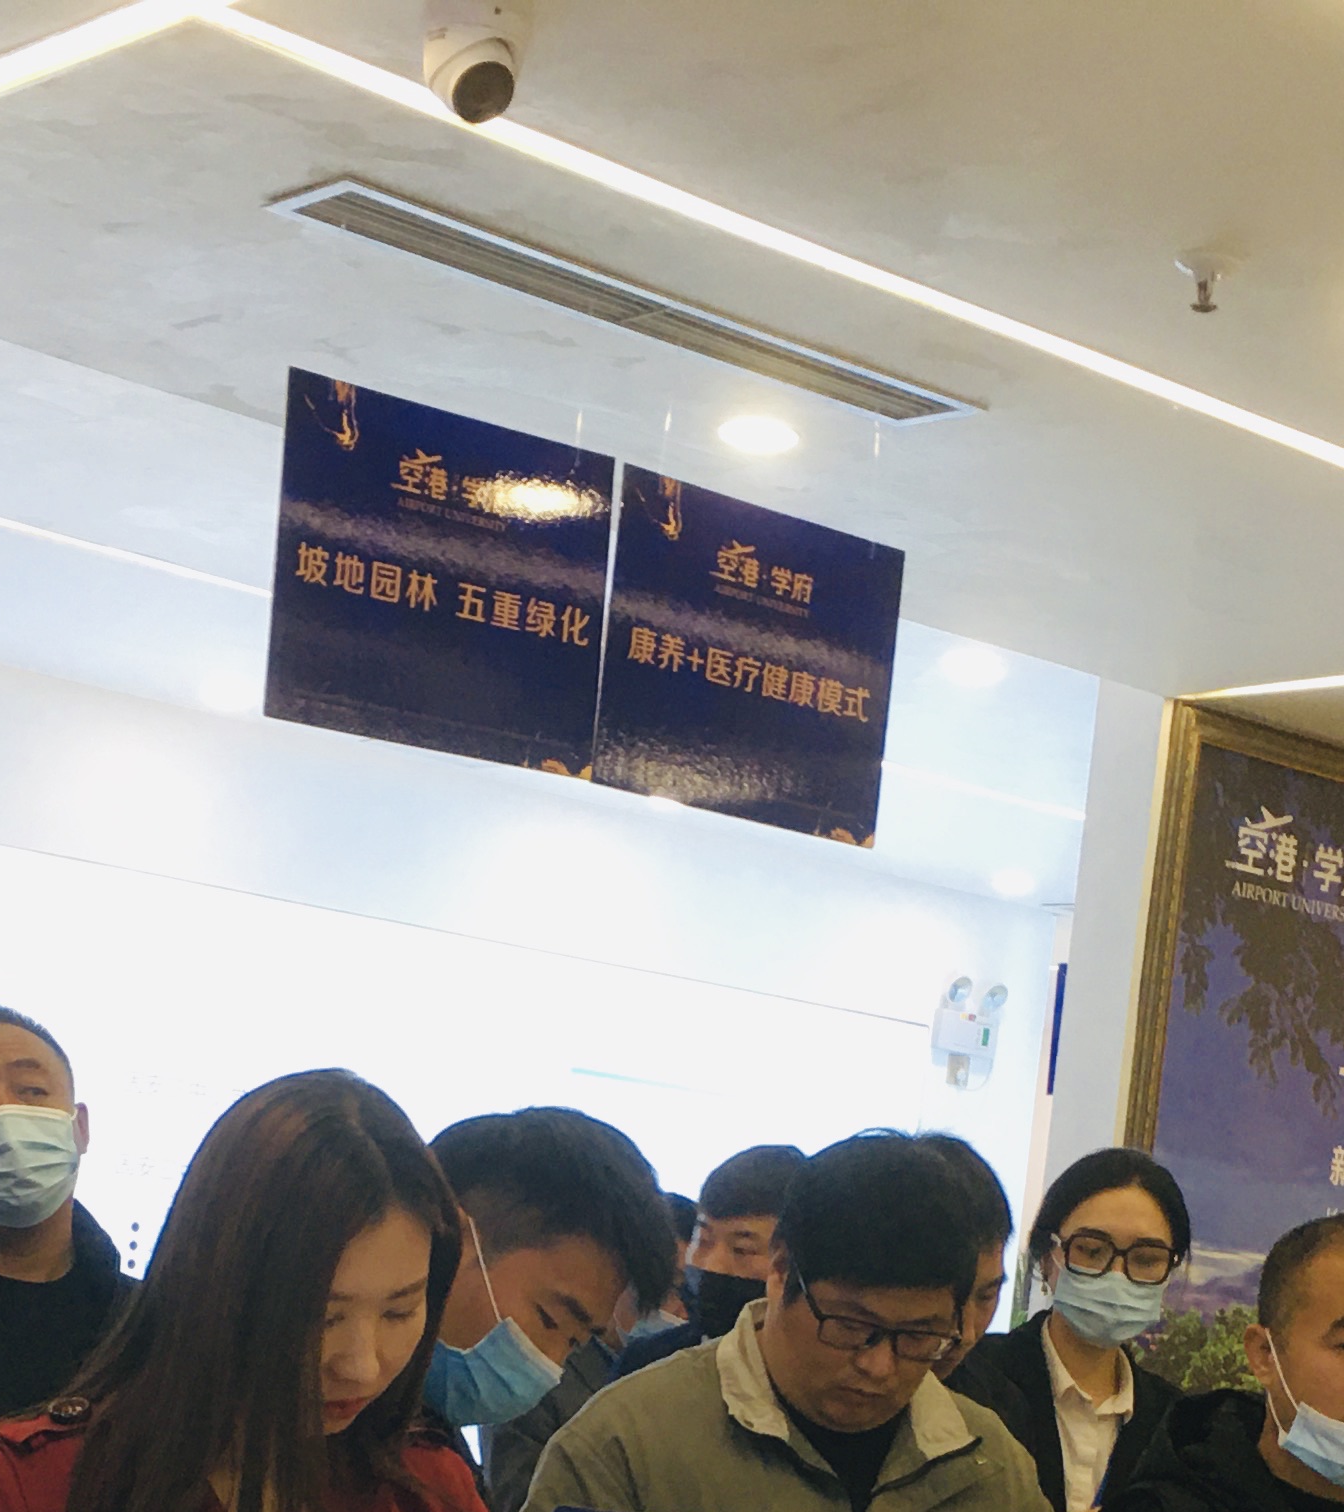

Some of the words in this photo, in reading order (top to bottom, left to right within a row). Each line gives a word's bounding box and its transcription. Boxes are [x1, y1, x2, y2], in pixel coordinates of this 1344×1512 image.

[296, 542, 439, 612] 坡地园林
[456, 583, 590, 647] 五重绿化
[628, 627, 871, 723] 康养+医疗健康模式
[1232, 880, 1288, 908] AIRPORT
